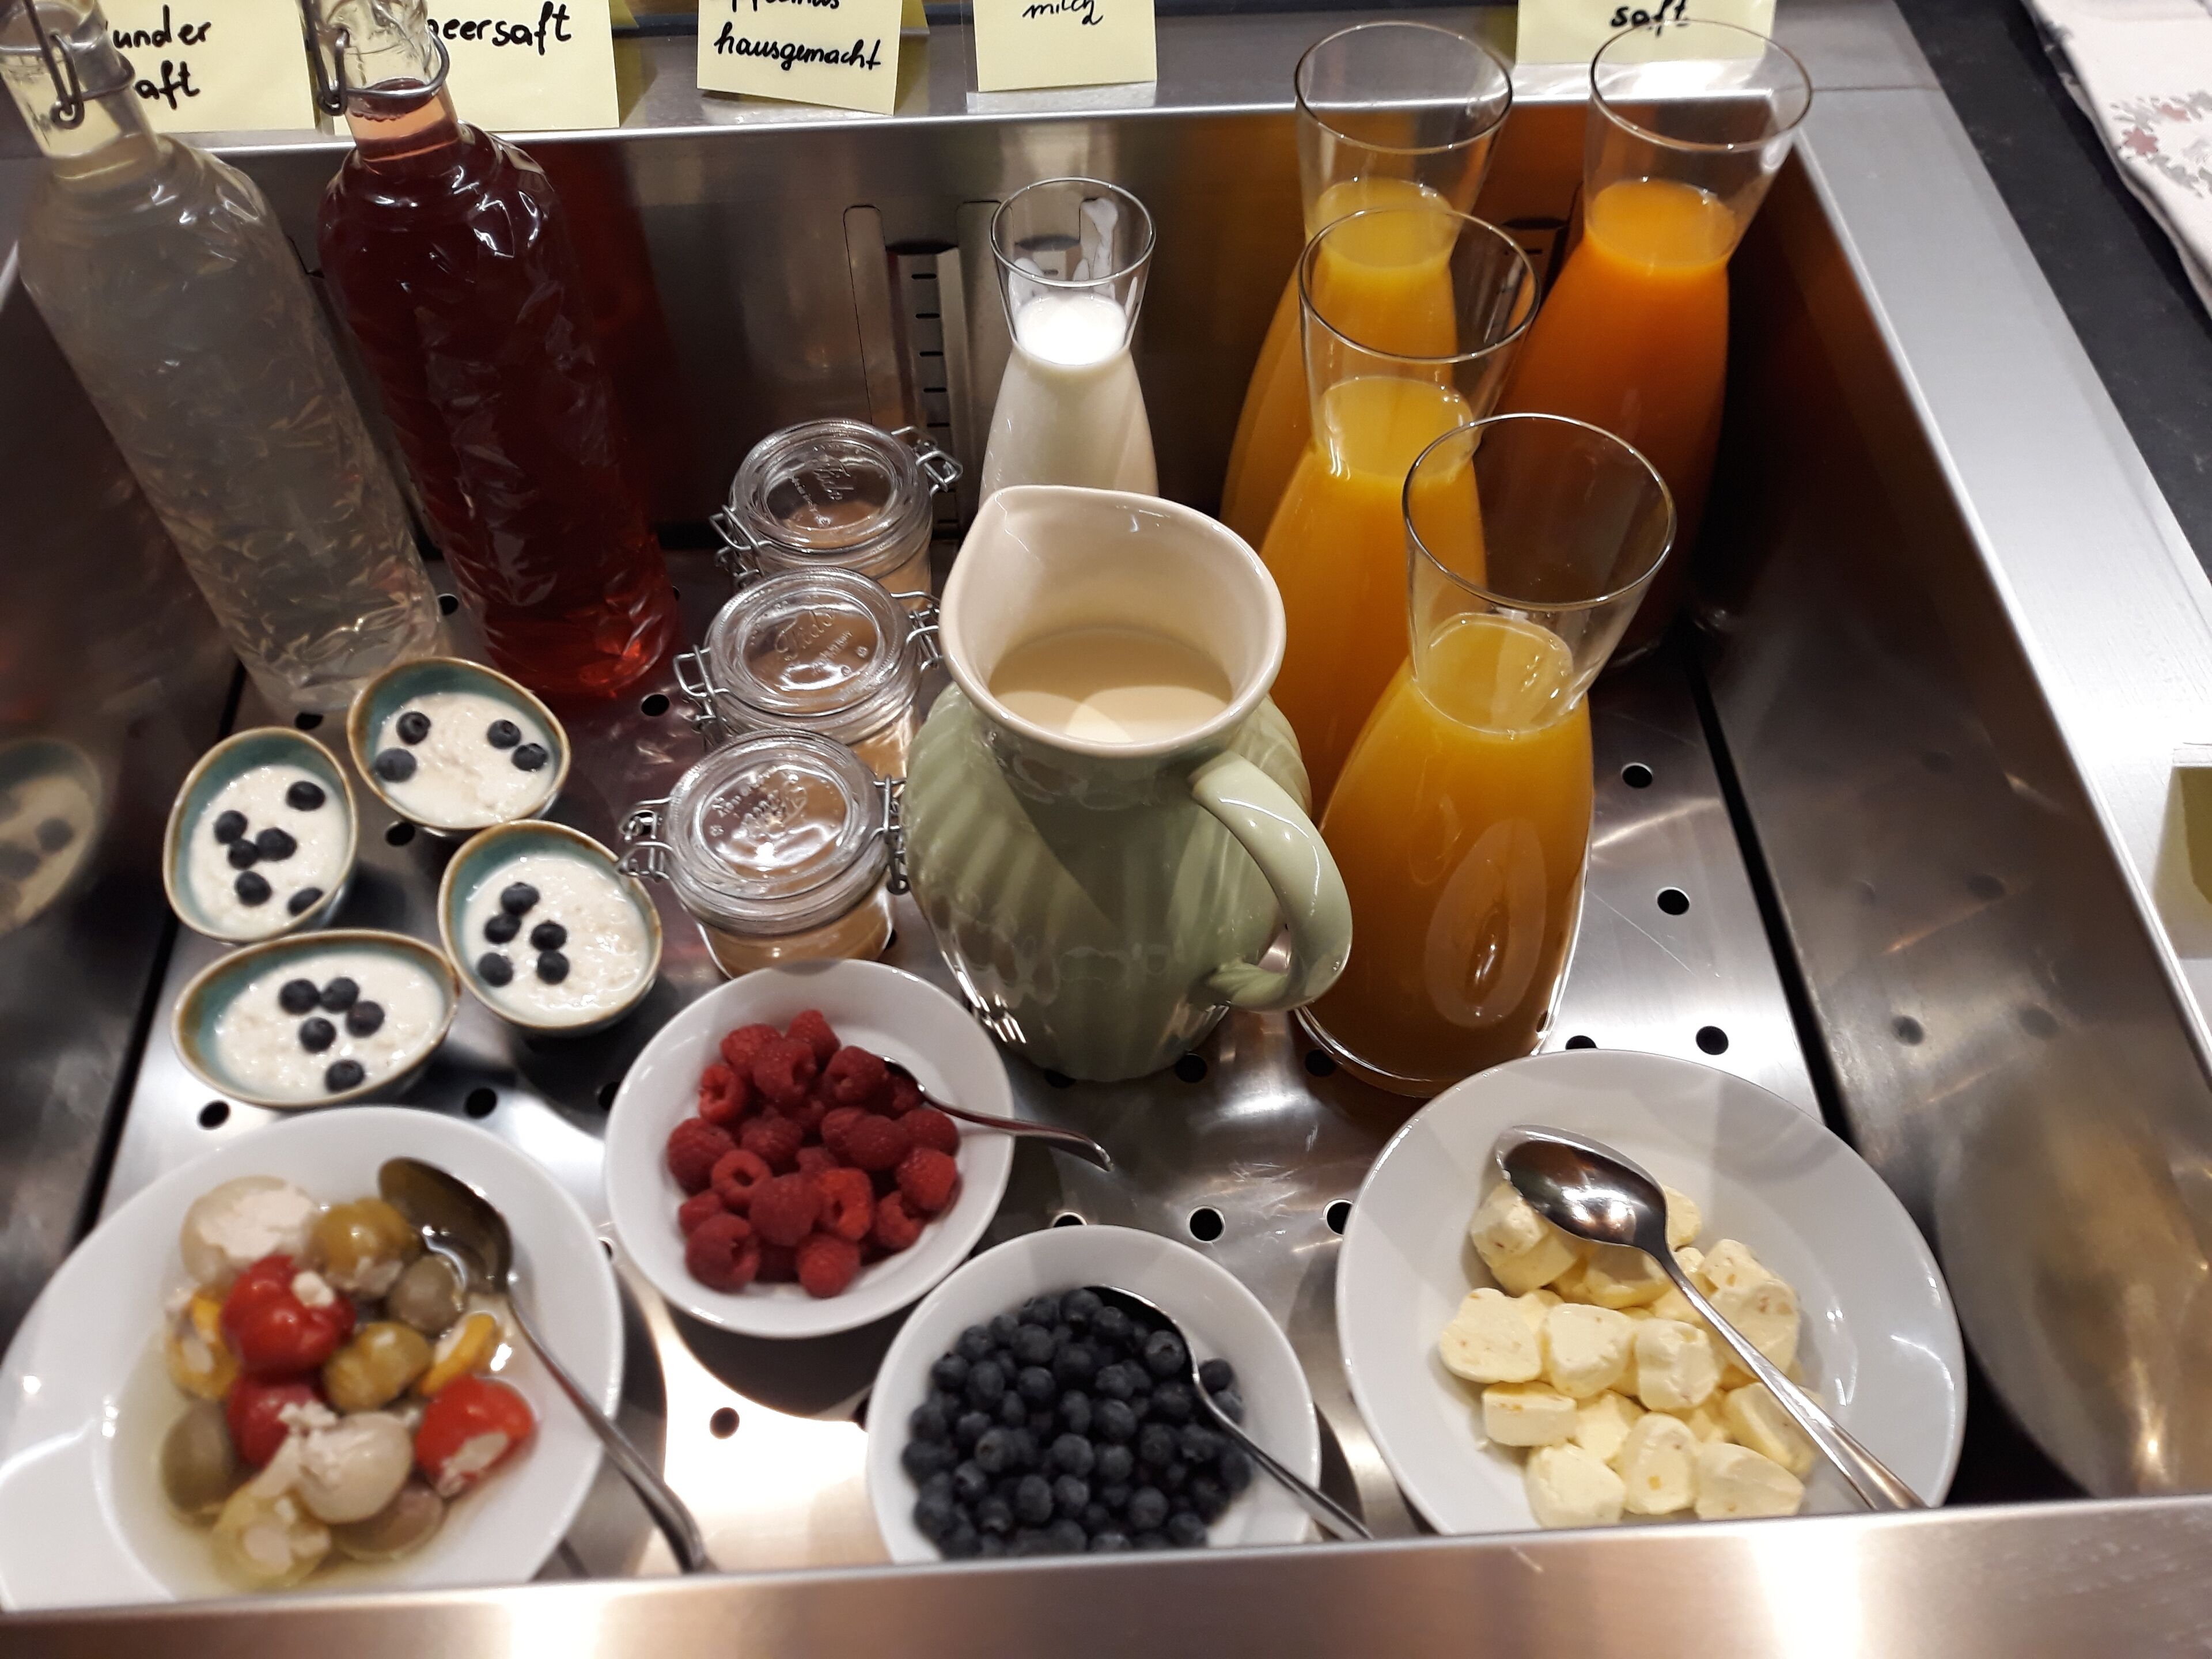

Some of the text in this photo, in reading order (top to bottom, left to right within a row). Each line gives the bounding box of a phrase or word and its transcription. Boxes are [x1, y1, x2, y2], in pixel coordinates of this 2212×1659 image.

[105, 4, 212, 48] under
[713, 21, 881, 71] hausgemacht
[133, 60, 200, 111] aft
